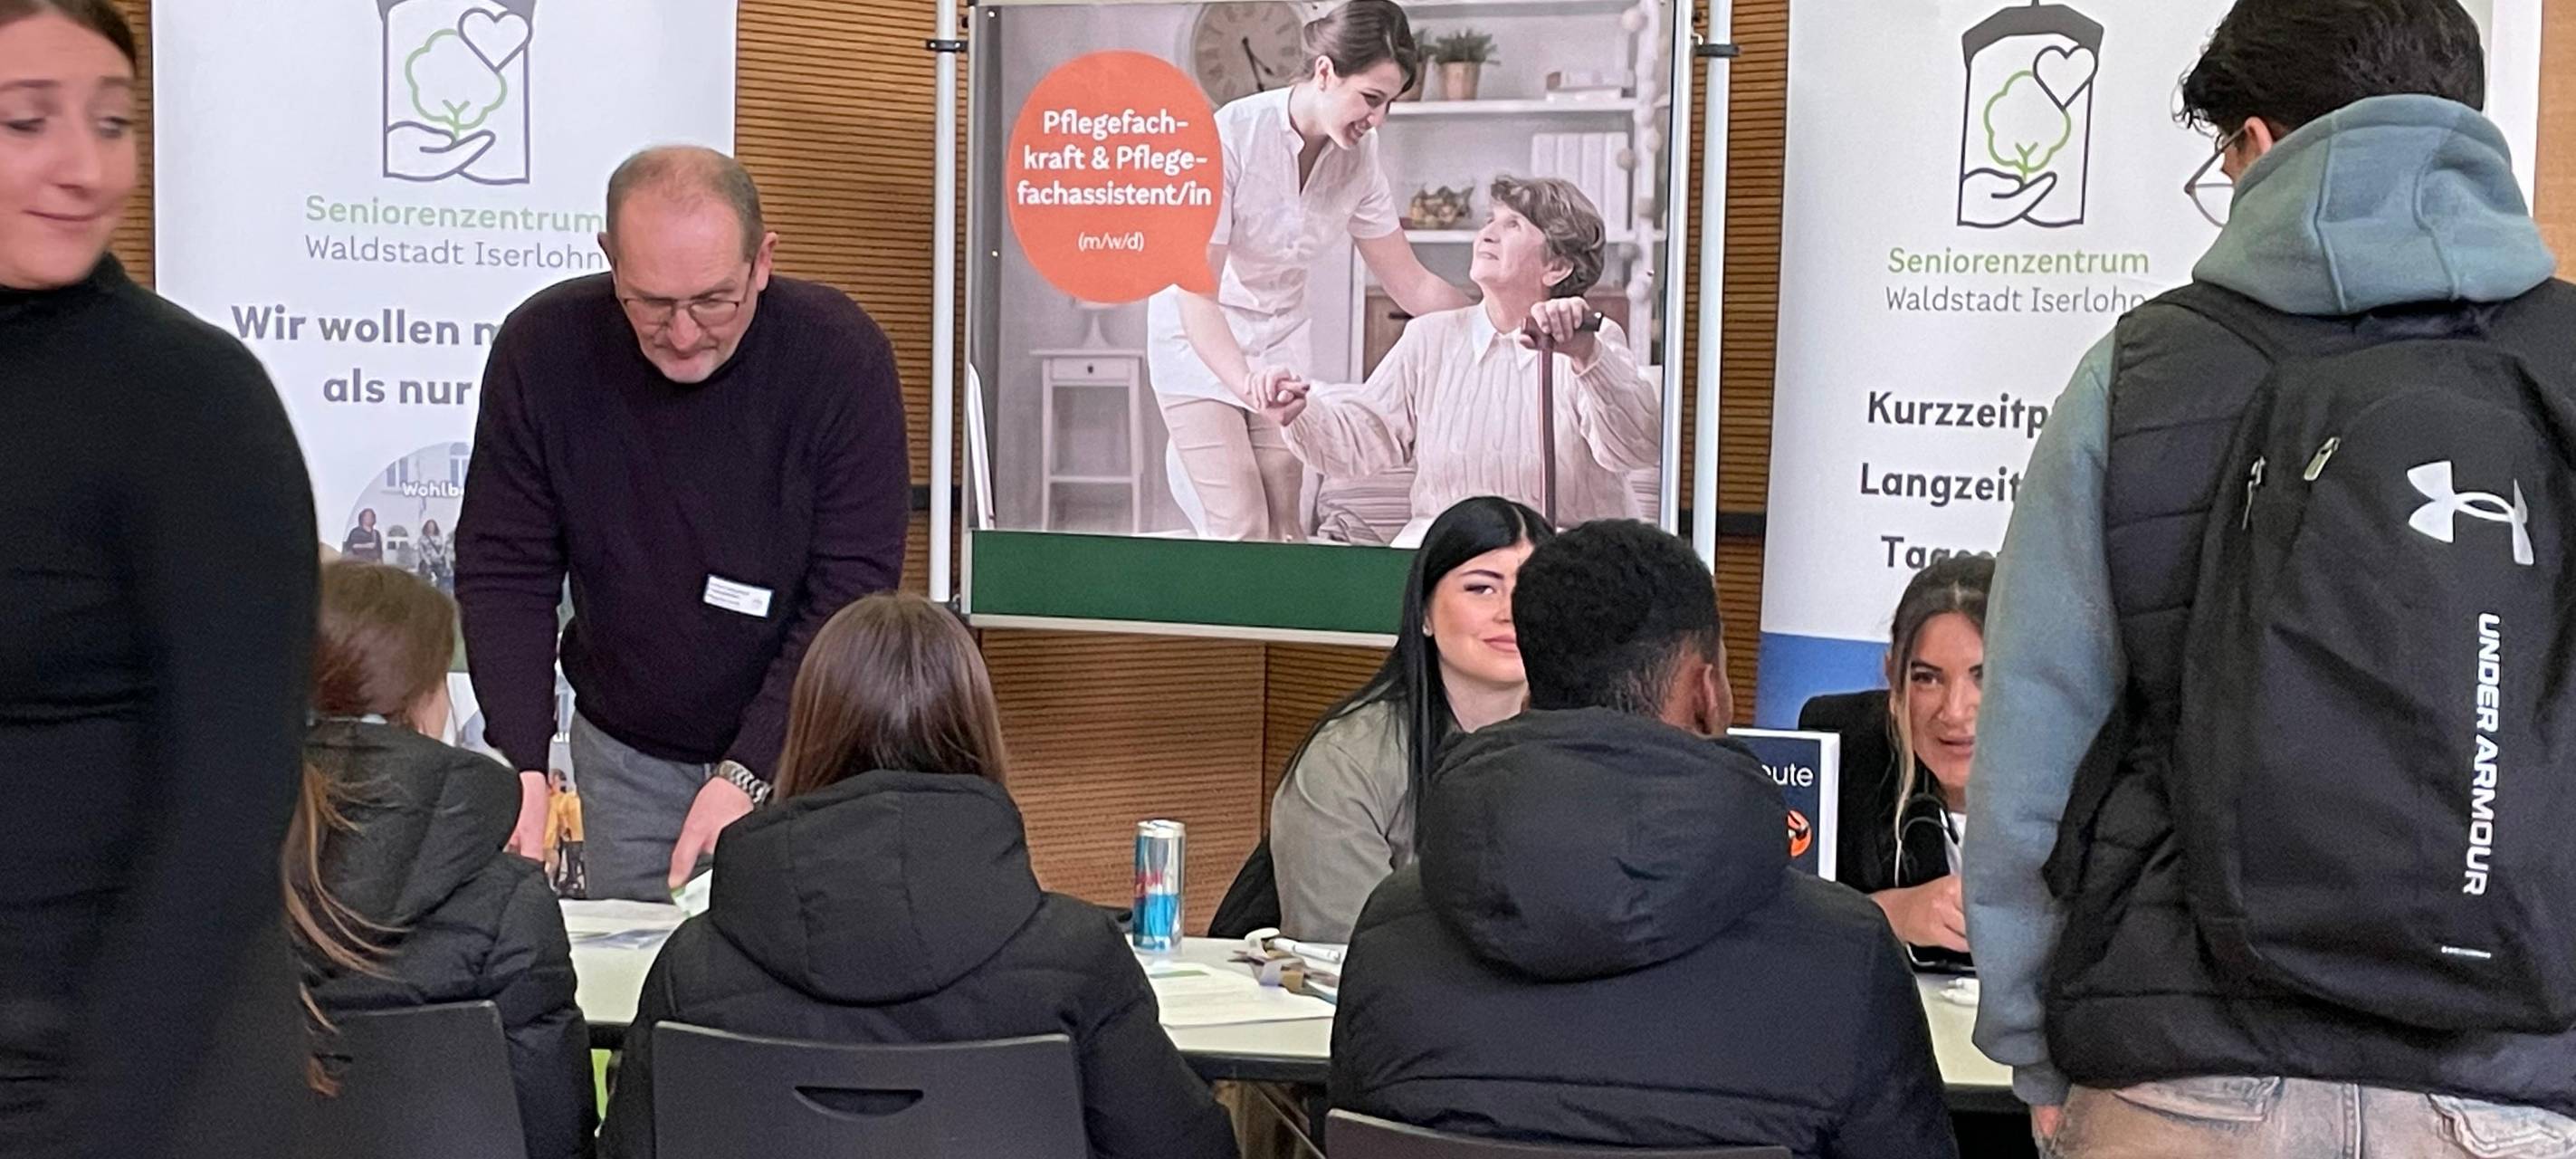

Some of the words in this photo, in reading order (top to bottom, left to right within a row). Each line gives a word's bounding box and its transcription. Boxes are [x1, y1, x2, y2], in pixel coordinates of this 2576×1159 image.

[1043, 108, 1189, 141] Pflegefach-
[1023, 144, 1086, 170] kraft
[1091, 145, 1110, 170] &
[1116, 144, 1208, 177] Pflege-
[1016, 179, 1213, 206] fachassistent/in
[306, 195, 604, 234] Seniorenzentrum
[305, 235, 464, 266] Waldstadt
[474, 242, 603, 269] Iserlohn
[1078, 231, 1145, 253] (m/w/d)
[1887, 247, 2150, 274] Seniorenzentrum
[1885, 284, 2023, 312] Waldstadt
[231, 303, 307, 340] Wir
[318, 309, 460, 345] wollen
[323, 368, 386, 403] als
[399, 379, 472, 405] nur
[1867, 390, 2049, 439] Kurzzeitp
[2476, 612, 2501, 733] UNDER
[2462, 733, 2499, 896] ARMOUR
